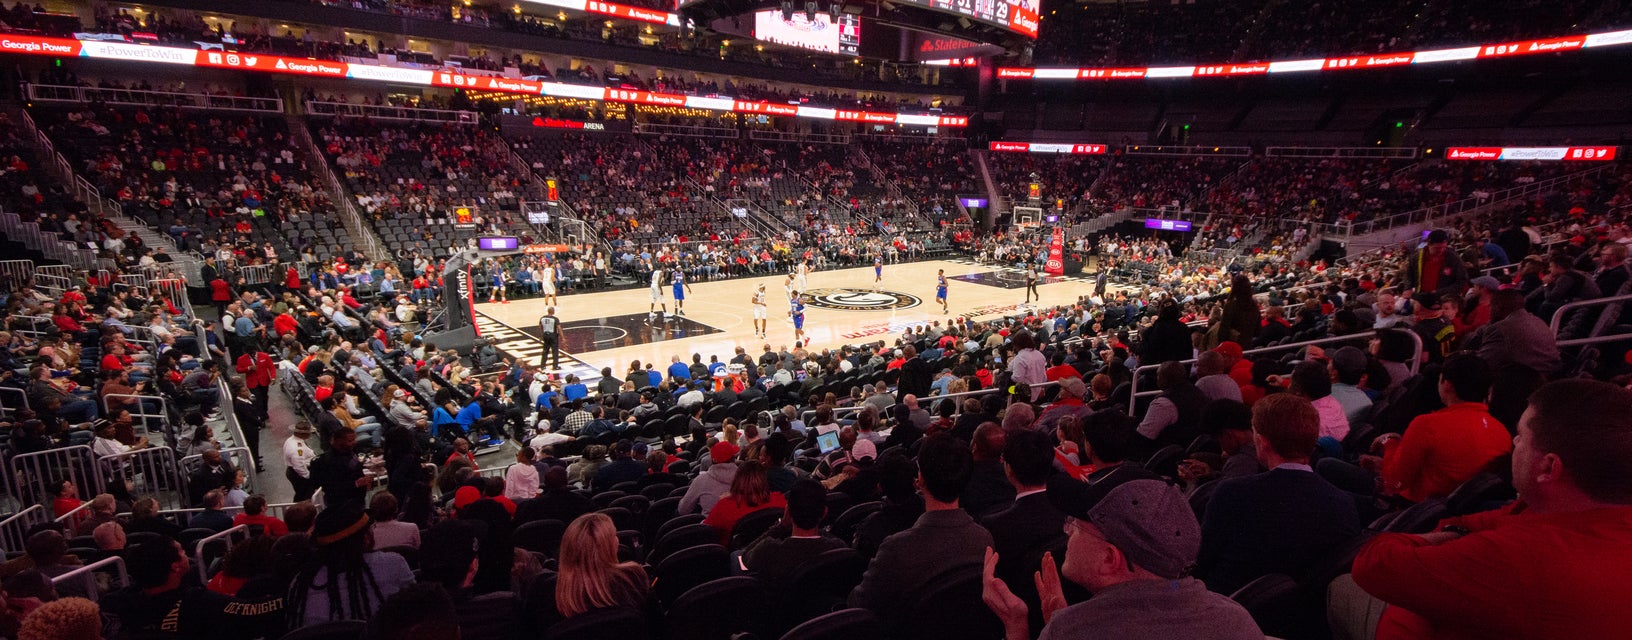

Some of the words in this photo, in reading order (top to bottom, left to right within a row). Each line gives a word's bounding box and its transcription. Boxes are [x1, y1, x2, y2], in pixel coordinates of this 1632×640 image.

[996, 2, 1008, 19] 29
[2, 39, 40, 51] Georgia
[42, 42, 71, 53] Power
[1539, 42, 1561, 50] Georgia
[1562, 40, 1580, 48] Power
[100, 45, 183, 60] #PowerToWin
[289, 62, 317, 73] Georgia
[319, 65, 341, 74] Power
[498, 82, 520, 91] Georgia
[521, 83, 537, 91] Power
[584, 122, 604, 130] ARENA
[457, 269, 469, 299] xfinity
